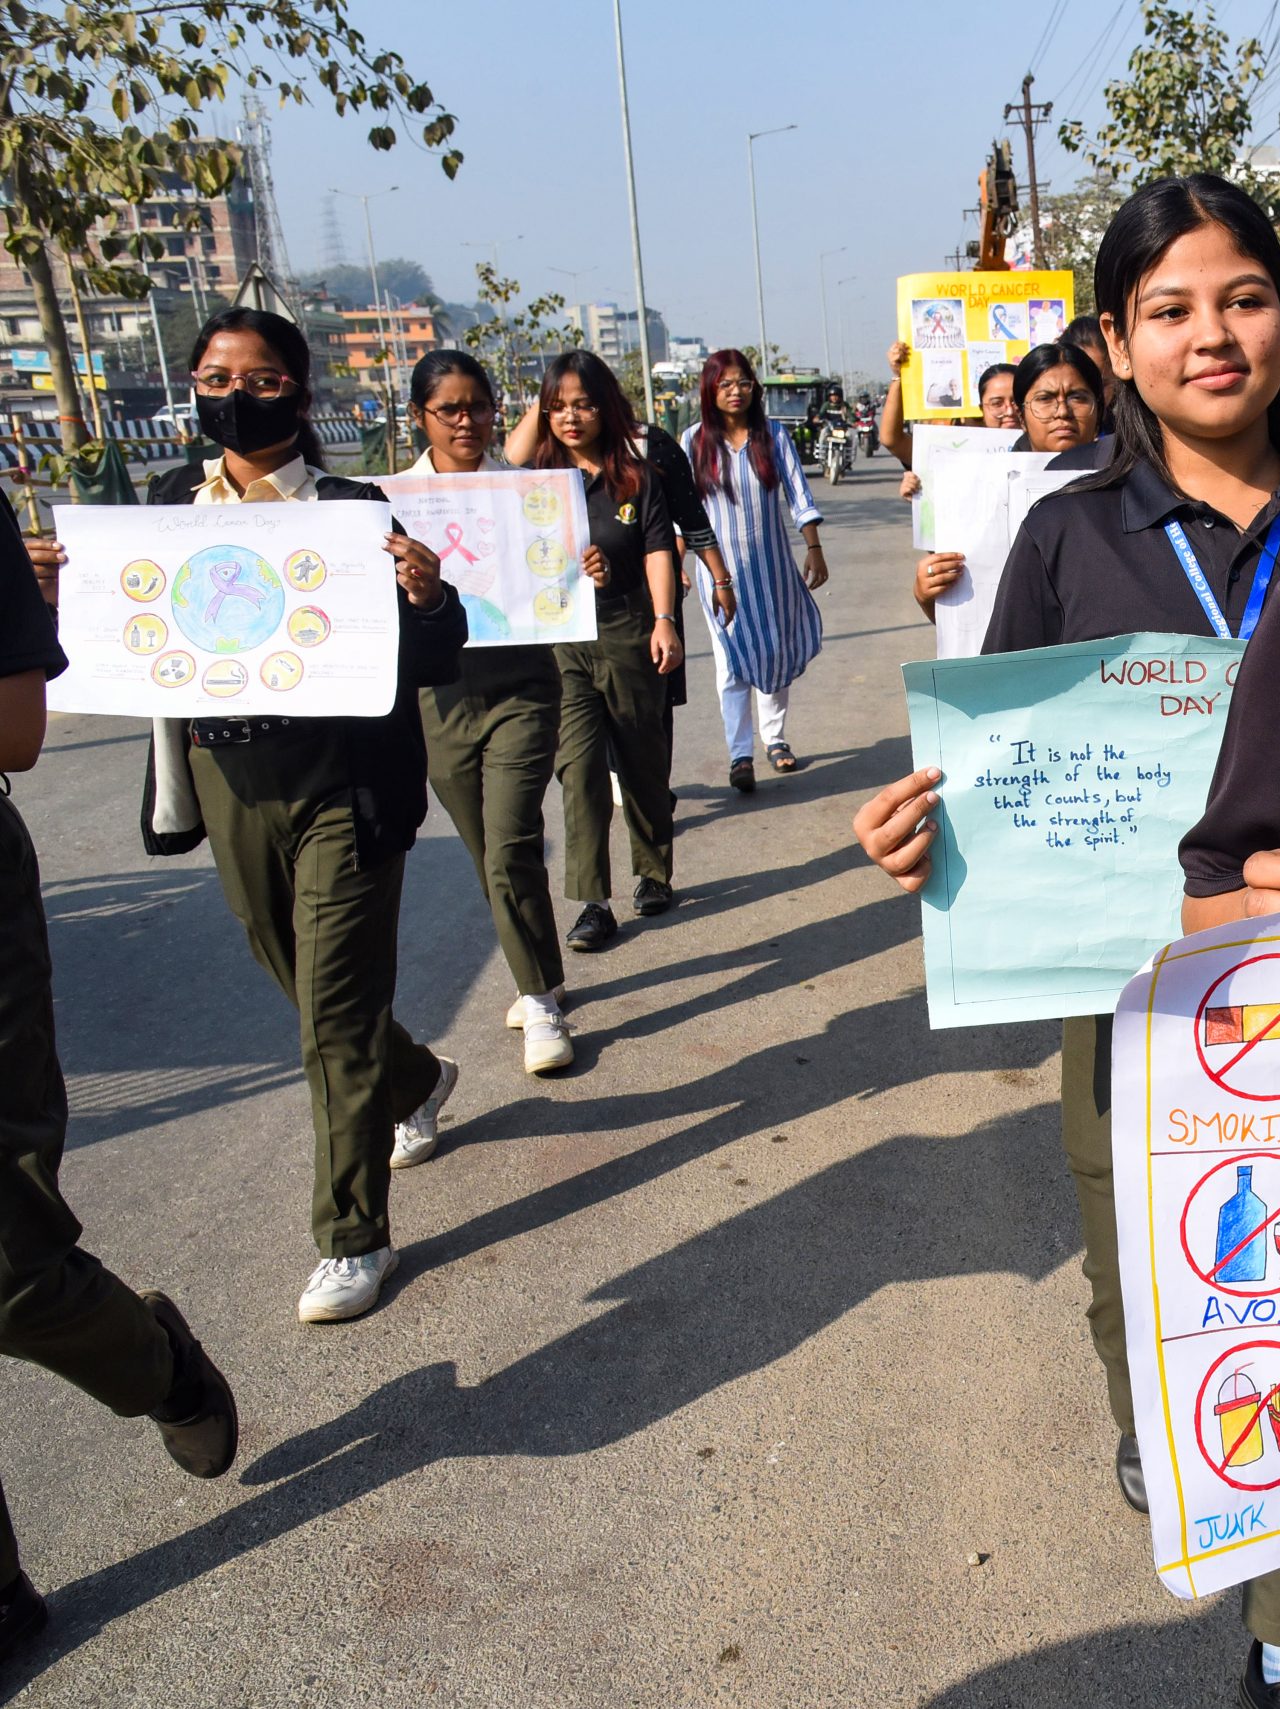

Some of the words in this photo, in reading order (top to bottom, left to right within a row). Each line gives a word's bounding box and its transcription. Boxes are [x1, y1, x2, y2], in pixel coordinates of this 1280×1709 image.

[936, 283, 986, 297] WORLD
[992, 282, 1040, 297] CANCER
[968, 297, 990, 309] DAY
[1174, 538, 1187, 550] of
[1183, 550, 1207, 591] College
[1101, 659, 1207, 686] WORLD
[1160, 692, 1222, 717] DAY
[1049, 748, 1061, 763] is
[1070, 743, 1093, 761] not
[1103, 744, 1125, 762] the
[974, 769, 1050, 796] strength
[1065, 763, 1082, 781] of
[1097, 765, 1120, 781] the
[1137, 763, 1171, 788] body
[994, 792, 1030, 810] that
[1115, 787, 1142, 802] but
[1014, 813, 1037, 828] the
[1050, 810, 1116, 834] strength
[1120, 808, 1135, 823] of
[1046, 827, 1071, 848] the
[1195, 1501, 1267, 1548] JUNK
